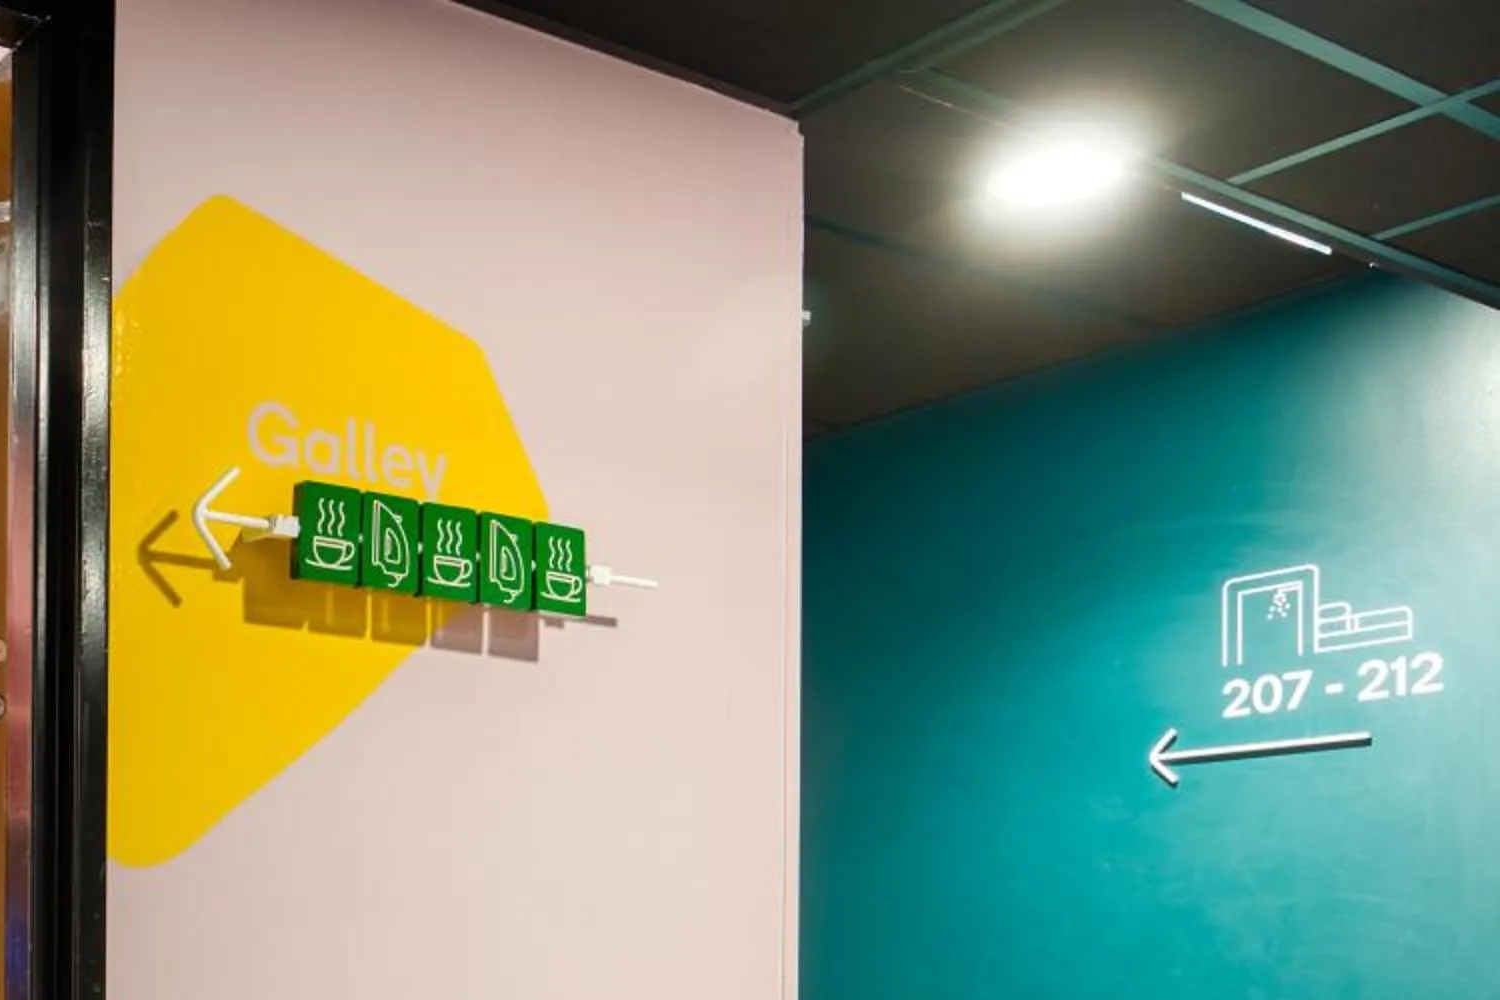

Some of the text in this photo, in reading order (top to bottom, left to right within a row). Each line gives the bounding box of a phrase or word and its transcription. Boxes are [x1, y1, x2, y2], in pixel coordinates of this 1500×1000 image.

[247, 399, 446, 503] Galley
[1221, 651, 1445, 719] 207 - 212
